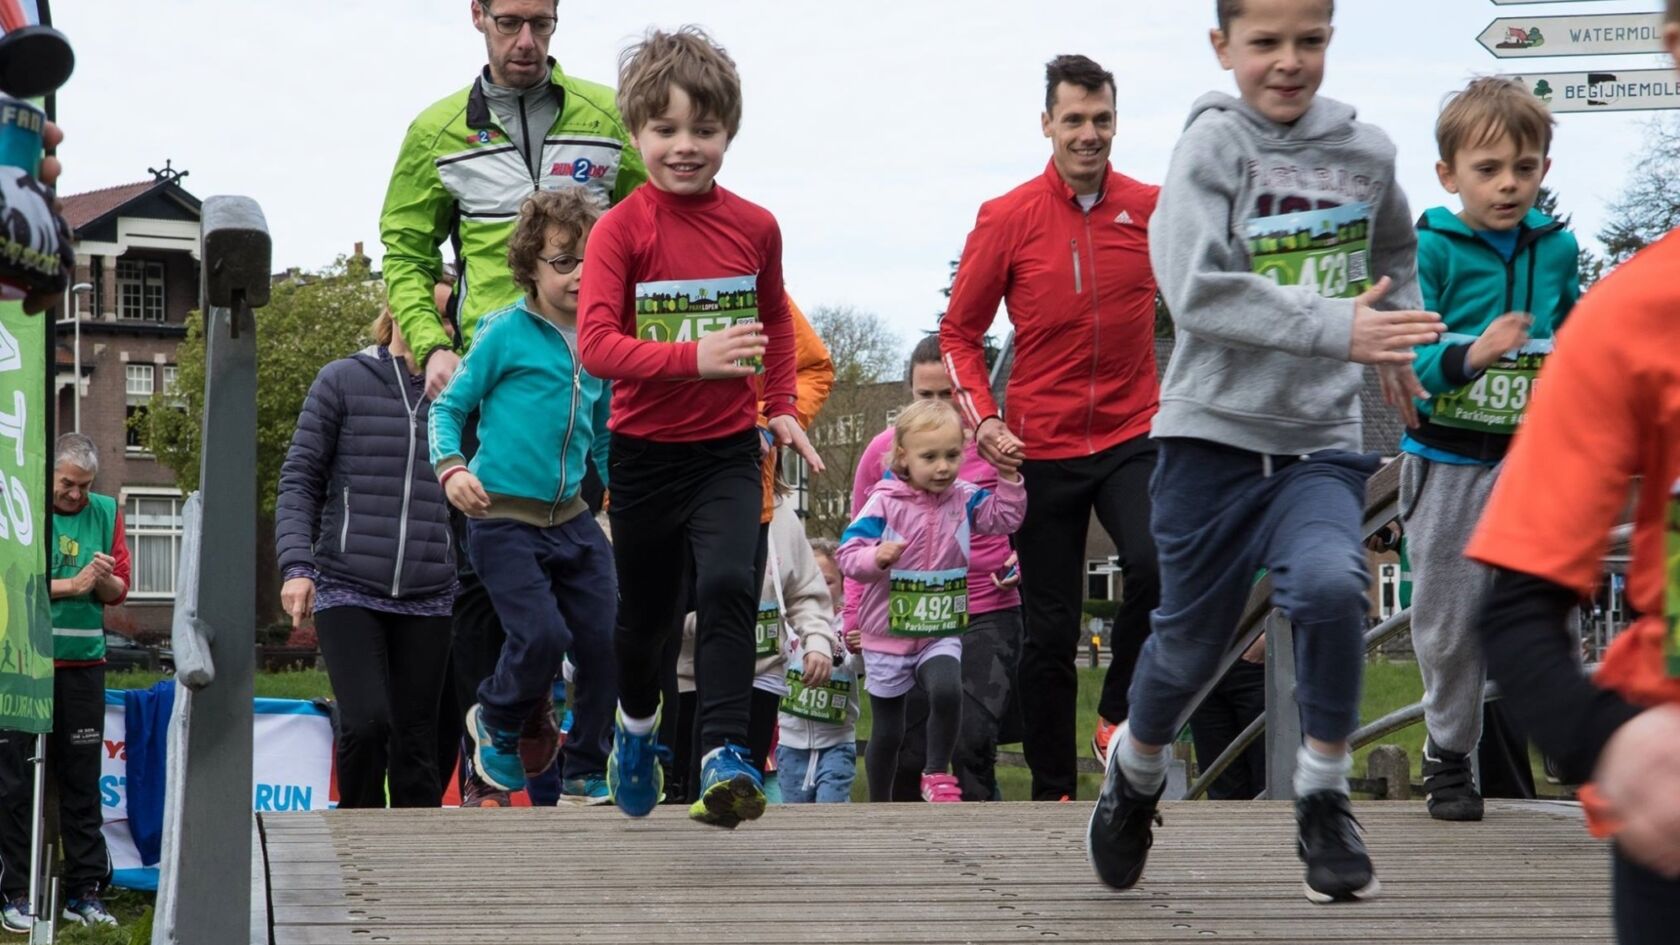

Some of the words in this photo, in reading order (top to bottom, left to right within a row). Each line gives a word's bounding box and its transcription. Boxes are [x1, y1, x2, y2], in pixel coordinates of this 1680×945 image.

[1569, 27, 1662, 43] WATERMOL
[1468, 374, 1527, 410] 493
[896, 599, 904, 614] 1
[913, 595, 953, 620] 492
[798, 687, 829, 709] 419
[100, 774, 126, 808] S
[255, 783, 312, 812] RUN
